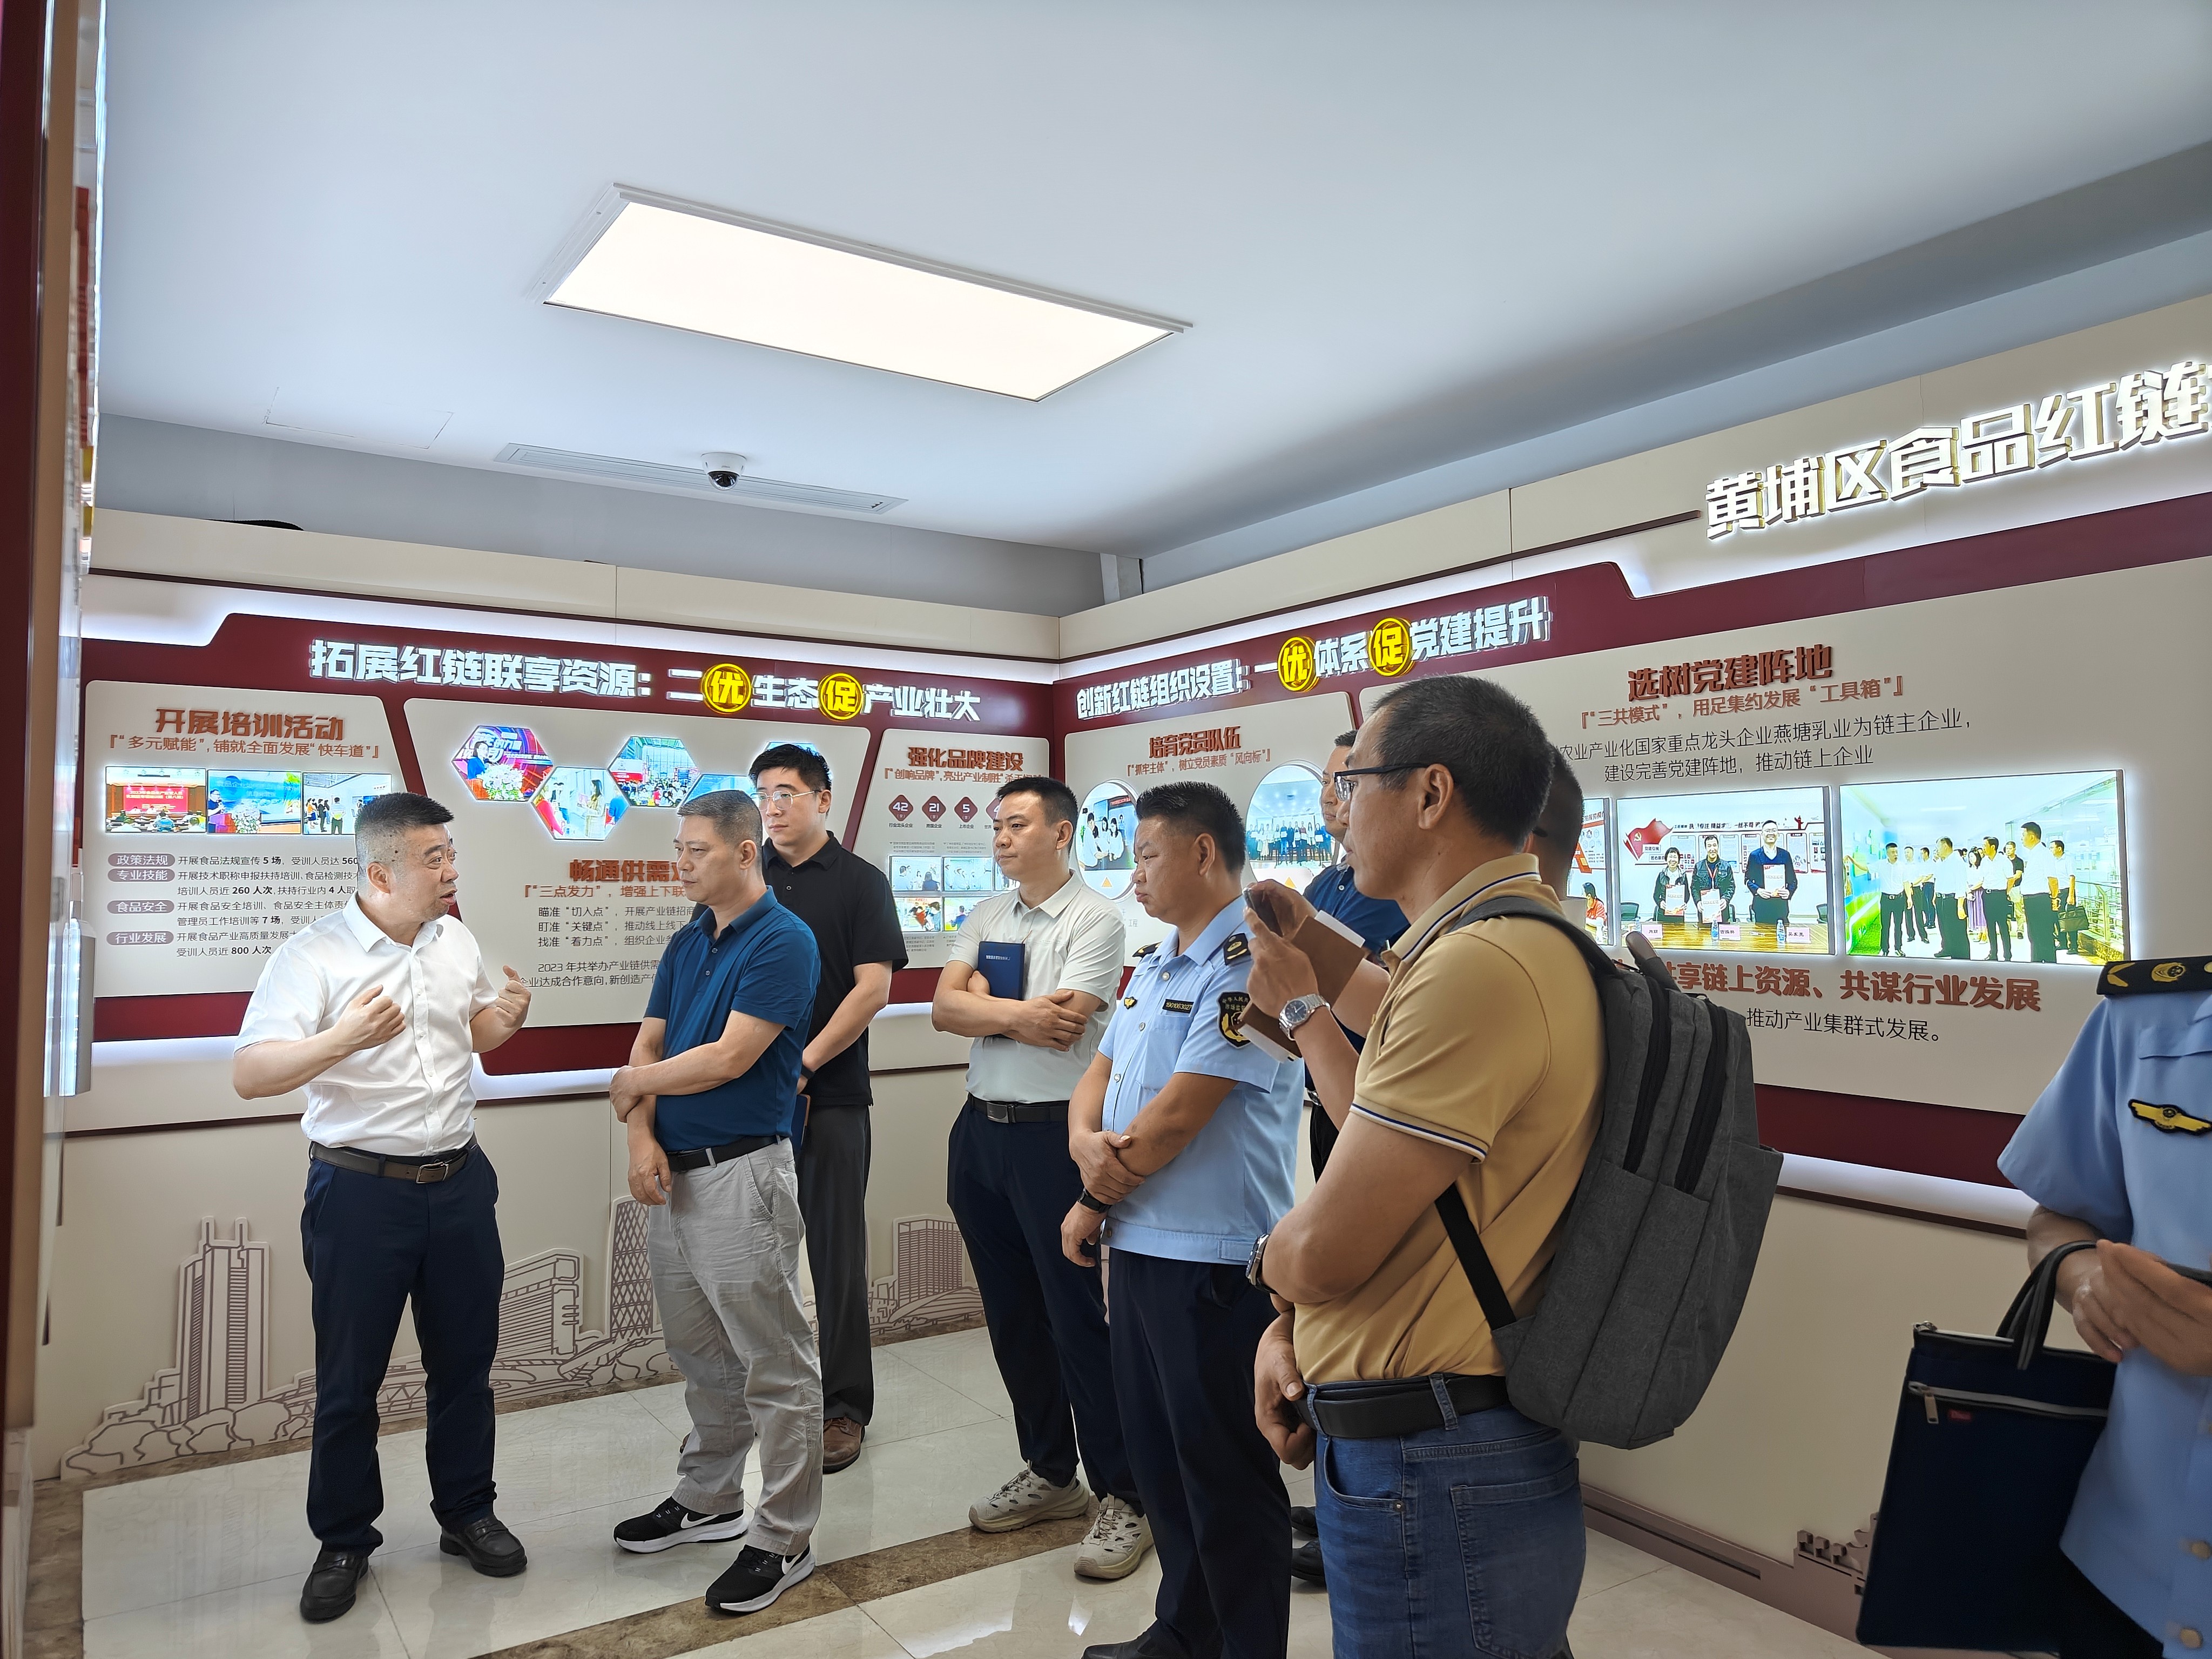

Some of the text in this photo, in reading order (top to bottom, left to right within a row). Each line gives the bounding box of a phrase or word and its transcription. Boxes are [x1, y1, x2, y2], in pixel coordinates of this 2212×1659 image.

[1705, 361, 2212, 539] 黄埔区食品红链
[1628, 644, 1832, 702] 选树党建阵地
[156, 708, 345, 740] 开展培训活动
[1555, 707, 1970, 761] 农业产业化国家重点龙头企业燕塘乳业为链主企业，
[1149, 726, 1241, 758] 培育党员队伍
[908, 747, 1023, 771] 强化品牌建设
[1604, 744, 1874, 783] 建设完善党建阵地，推动链上企业
[893, 802, 908, 812] 42
[929, 803, 940, 812] 21
[962, 804, 970, 813] 5
[117, 854, 168, 865] 政策法规
[178, 856, 261, 866] 开展食品法规宣传
[117, 870, 168, 881] 专业技能
[178, 886, 230, 895] 培训人员近
[337, 886, 357, 894] 人取
[524, 884, 686, 898] 『“三点发力”，增强上下联
[116, 902, 167, 913] 食品安全
[177, 916, 259, 926] 管理员工作培训等
[271, 916, 325, 925] 场，受训人
[538, 920, 689, 932] 盯准“关键点”，推动线上线下
[115, 932, 167, 943] 行业发展
[177, 945, 272, 957] 受训人员近 800 人次
[538, 963, 563, 973] 2023
[1746, 1007, 1939, 1042] 推动产业集群式发展。
